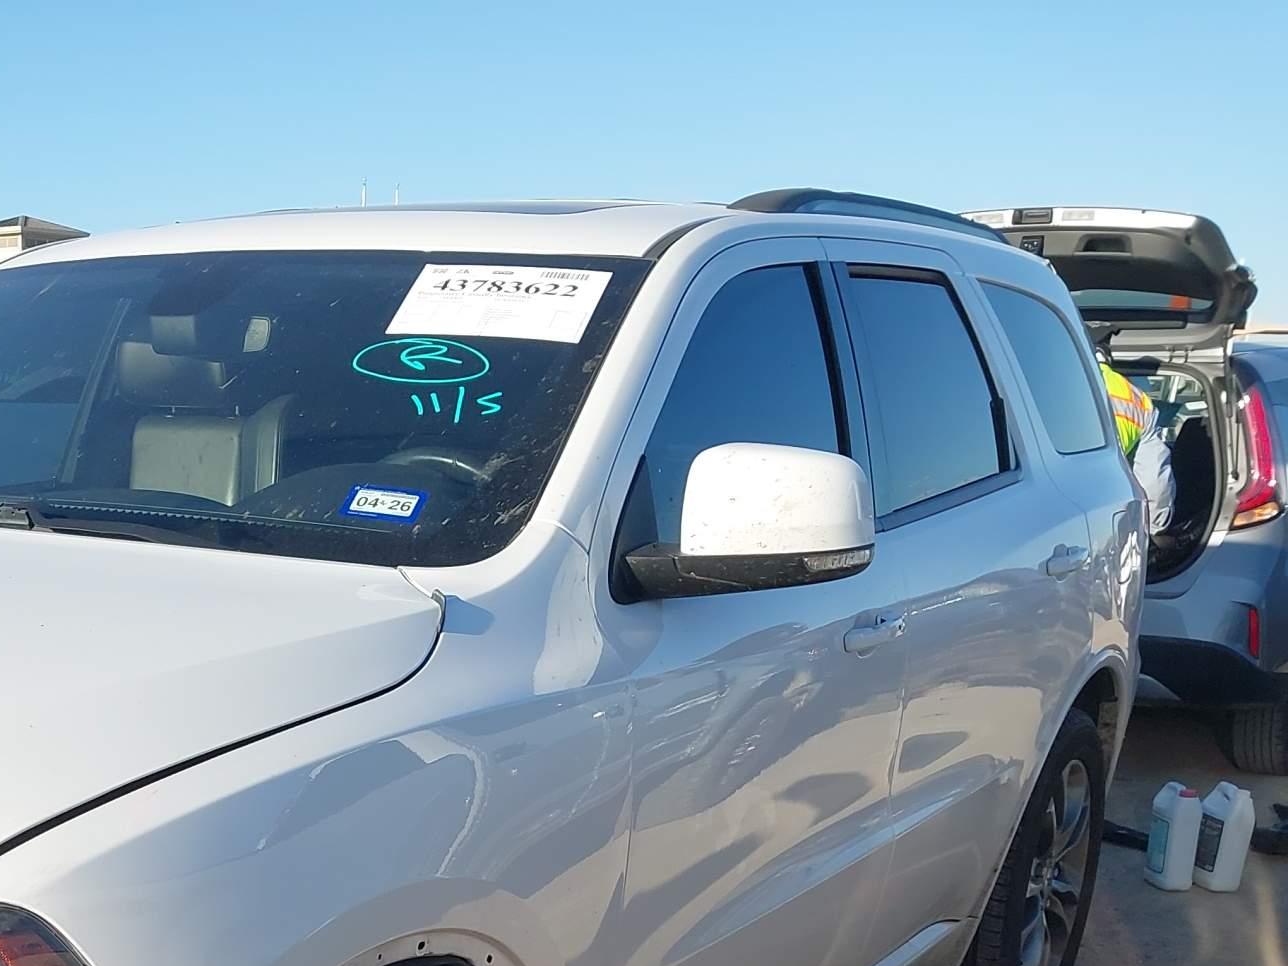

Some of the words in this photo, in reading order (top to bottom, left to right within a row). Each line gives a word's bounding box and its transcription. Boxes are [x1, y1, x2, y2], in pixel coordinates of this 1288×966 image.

[432, 278, 579, 297] 43783622
[356, 496, 380, 508] 04
[387, 500, 413, 512] 26
